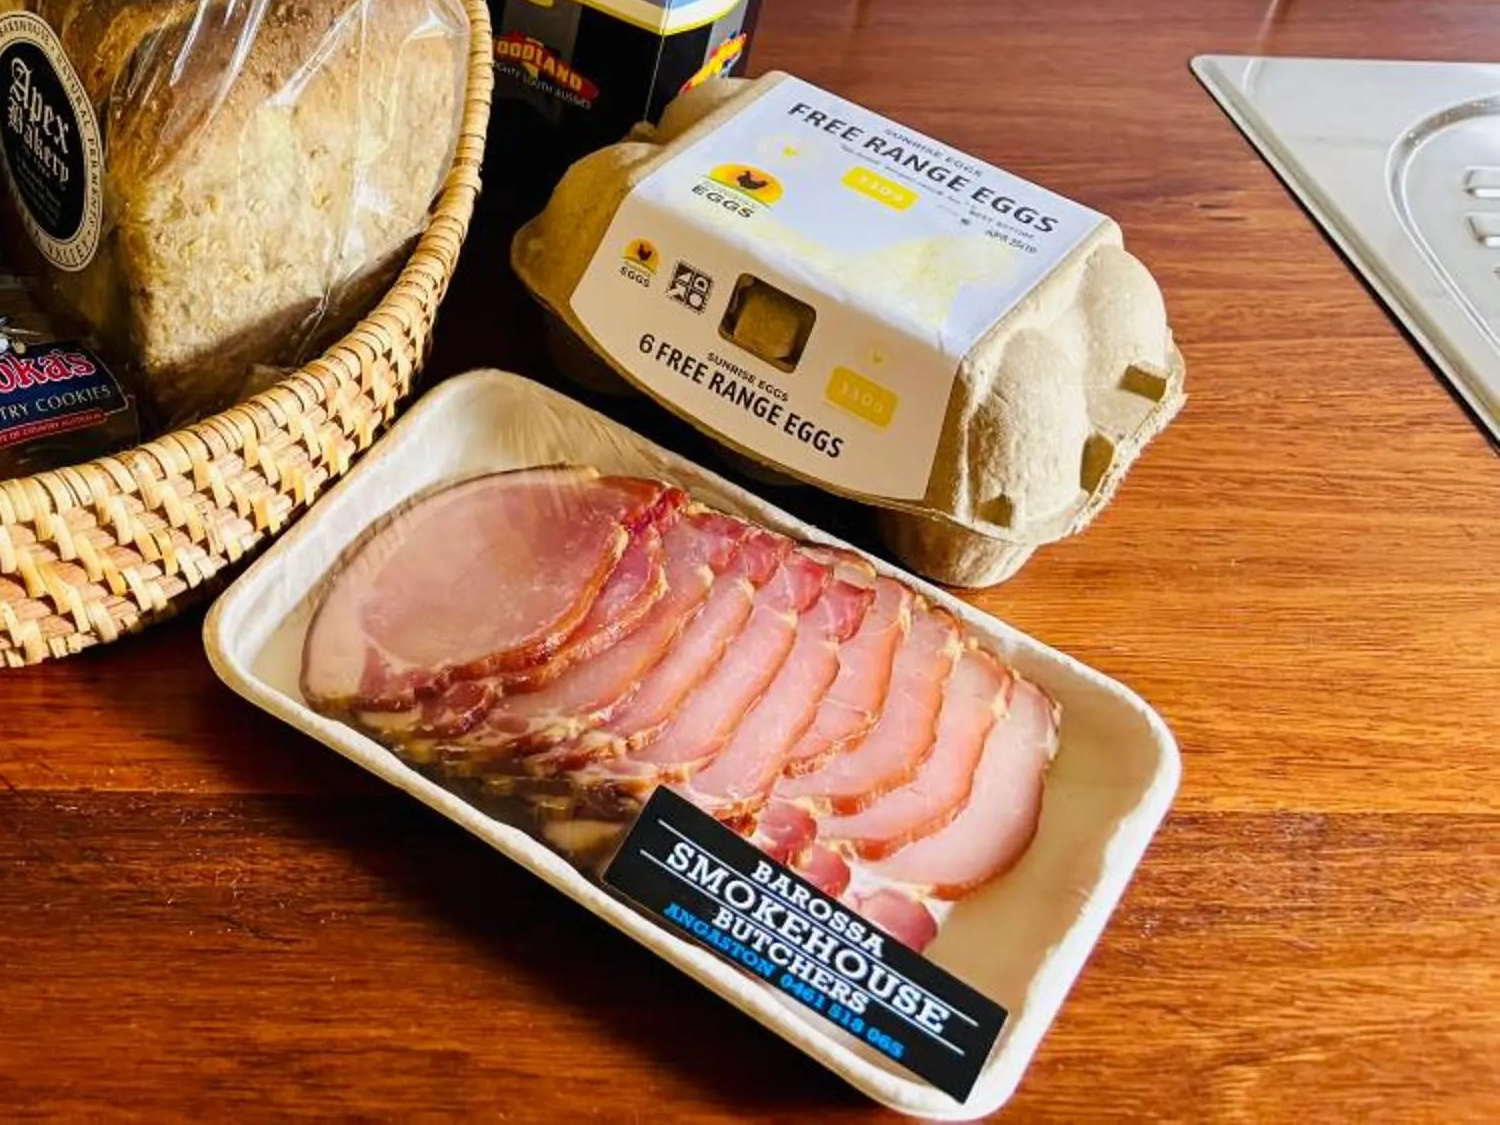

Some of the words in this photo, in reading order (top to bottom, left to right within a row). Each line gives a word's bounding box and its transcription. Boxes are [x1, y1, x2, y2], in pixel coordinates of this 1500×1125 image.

[493, 39, 582, 92] OODLAND
[691, 184, 756, 218] EGGS
[787, 101, 865, 142] FREE
[863, 135, 971, 193] RANGE
[970, 185, 1059, 234] EGGS
[35, 383, 112, 413] COOKIES
[638, 333, 654, 356] 6
[656, 340, 711, 386] FREE
[707, 372, 785, 427] RANGE
[783, 412, 845, 459] EGGS
[706, 351, 756, 385] SUNRISE
[757, 379, 789, 404] EGGS
[663, 901, 778, 978] ANGASTON
[666, 842, 952, 1035] SMOKEHOUSE
[750, 859, 886, 959] BAROSSA
[711, 906, 870, 1015] BUTCHERS
